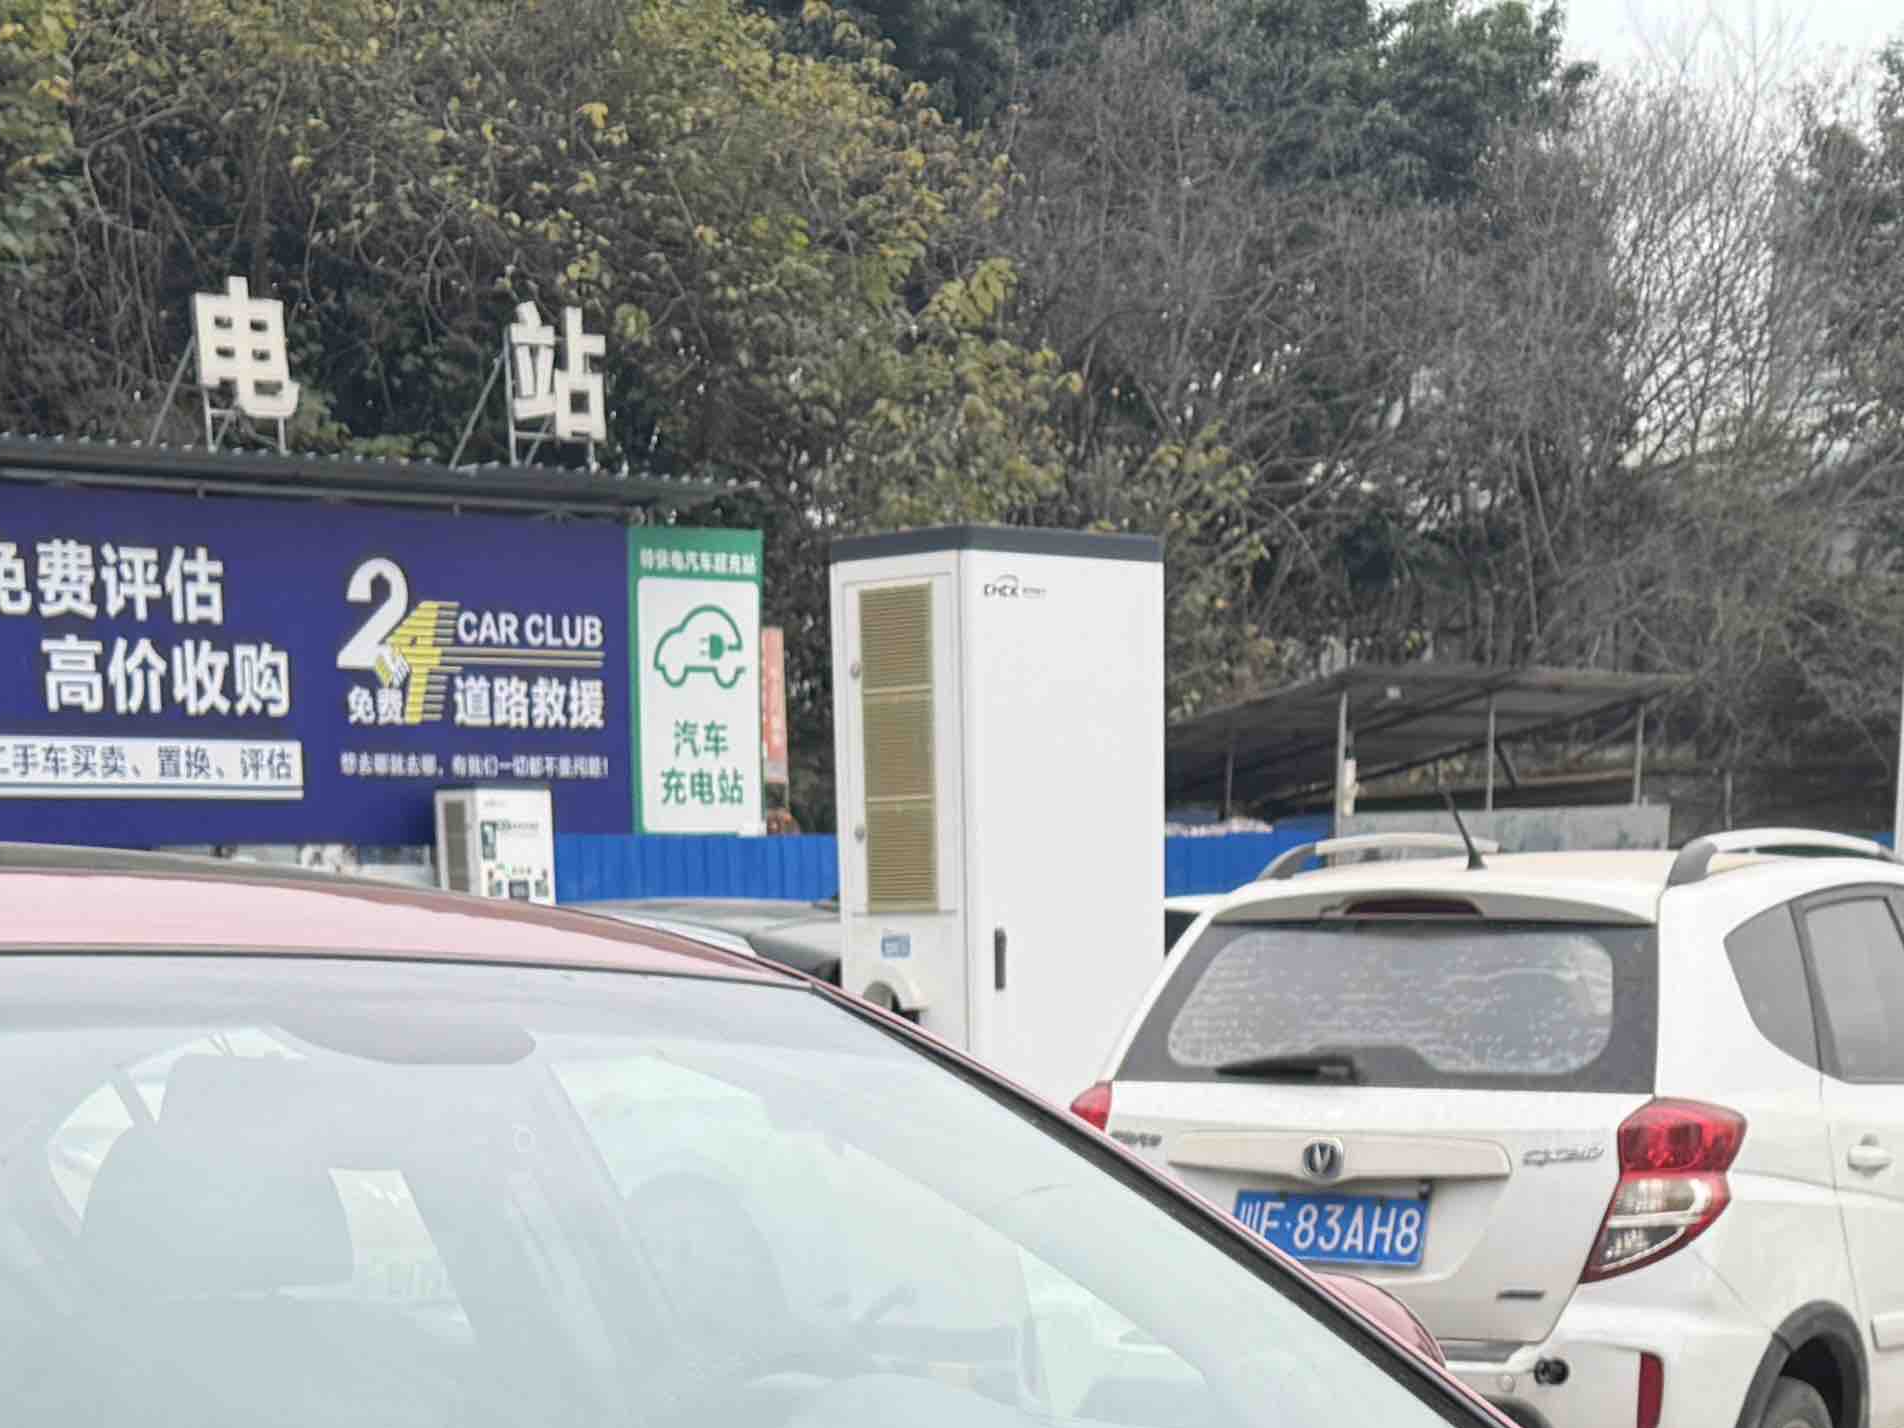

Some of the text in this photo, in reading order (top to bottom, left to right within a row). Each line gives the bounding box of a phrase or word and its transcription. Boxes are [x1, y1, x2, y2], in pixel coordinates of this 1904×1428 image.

[457, 610, 604, 647] CAR CLUB
[41, 634, 290, 717] 高价收购
[347, 674, 605, 729] 免费 道路救援
[673, 720, 728, 758] 汽车
[660, 767, 744, 806] 充电站
